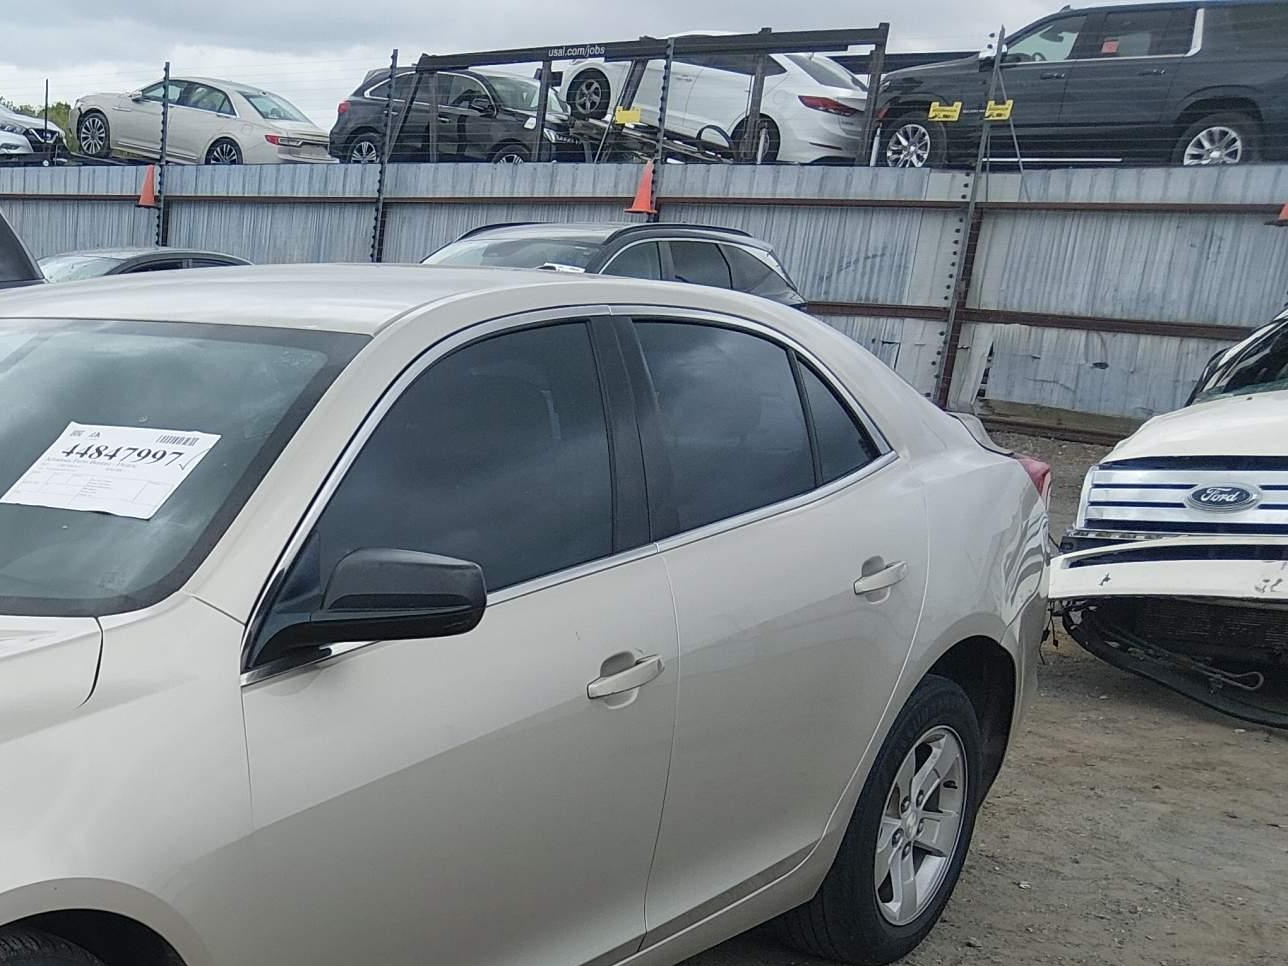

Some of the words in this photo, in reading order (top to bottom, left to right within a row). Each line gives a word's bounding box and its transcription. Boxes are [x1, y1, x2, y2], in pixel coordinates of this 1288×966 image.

[548, 41, 605, 57] usal.com/jobs
[62, 443, 184, 467] 44847997
[1201, 487, 1240, 502] Ford
